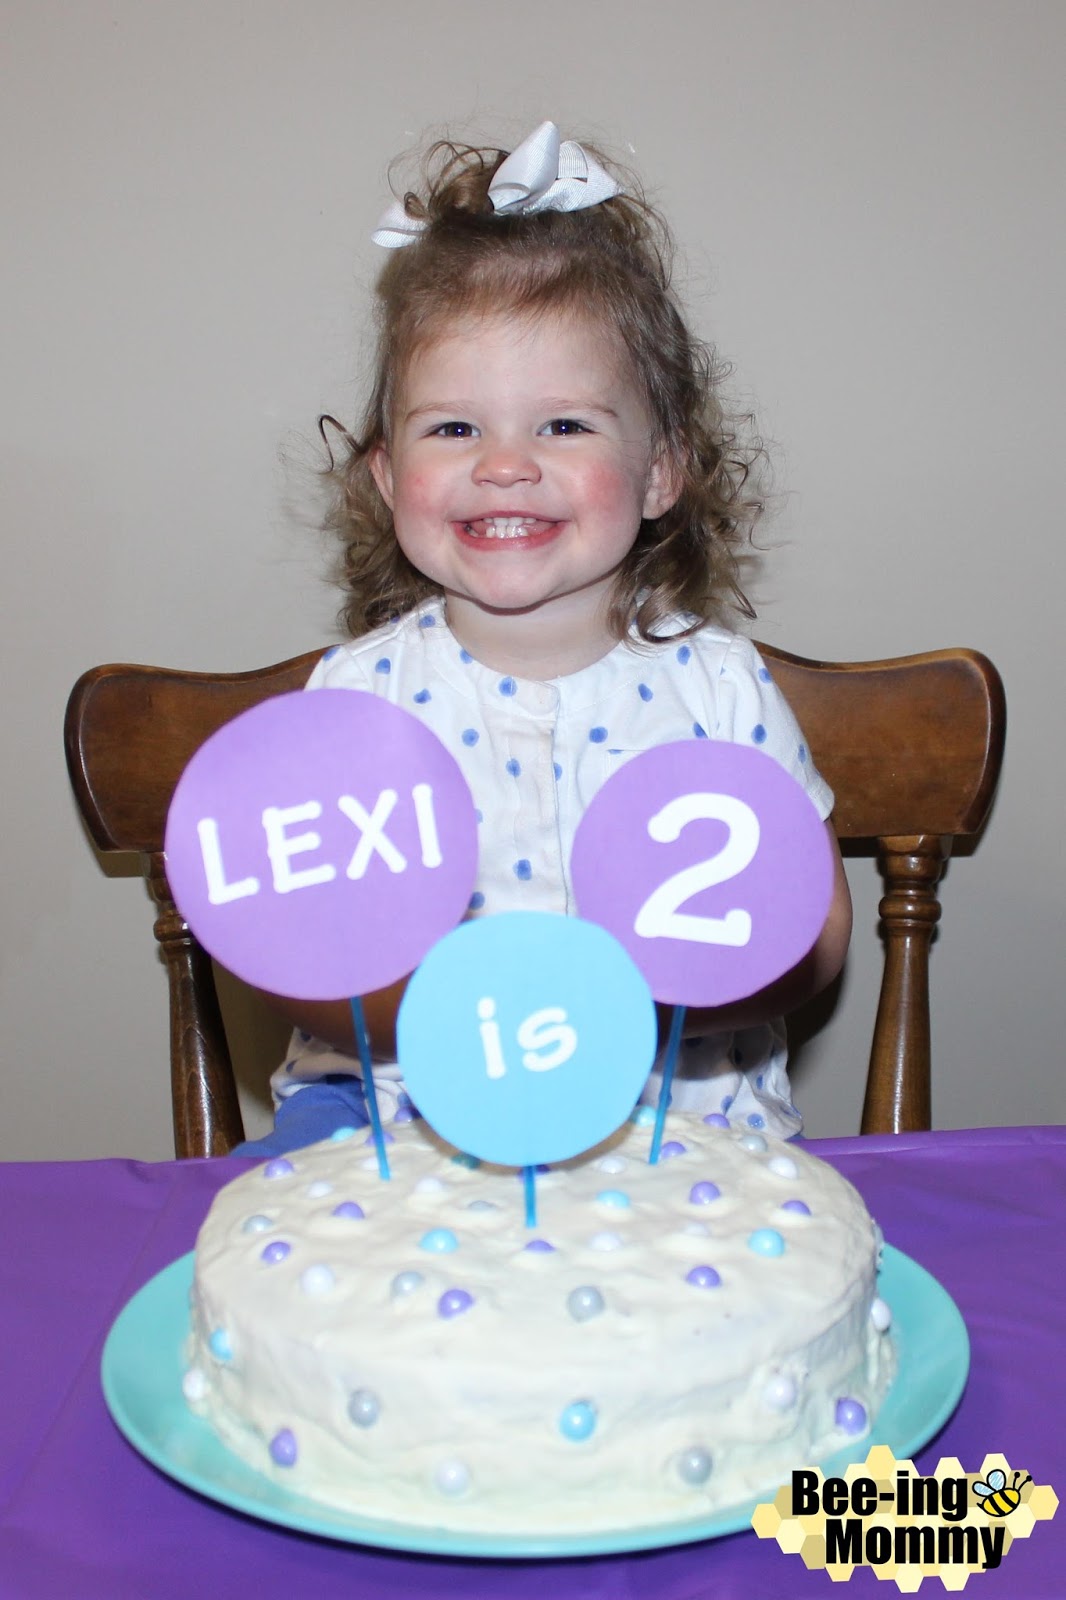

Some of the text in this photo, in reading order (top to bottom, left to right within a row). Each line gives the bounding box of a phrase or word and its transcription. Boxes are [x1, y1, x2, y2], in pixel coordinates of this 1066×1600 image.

[196, 782, 443, 906] LEXI
[633, 792, 761, 947] 2
[477, 997, 577, 1078] is
